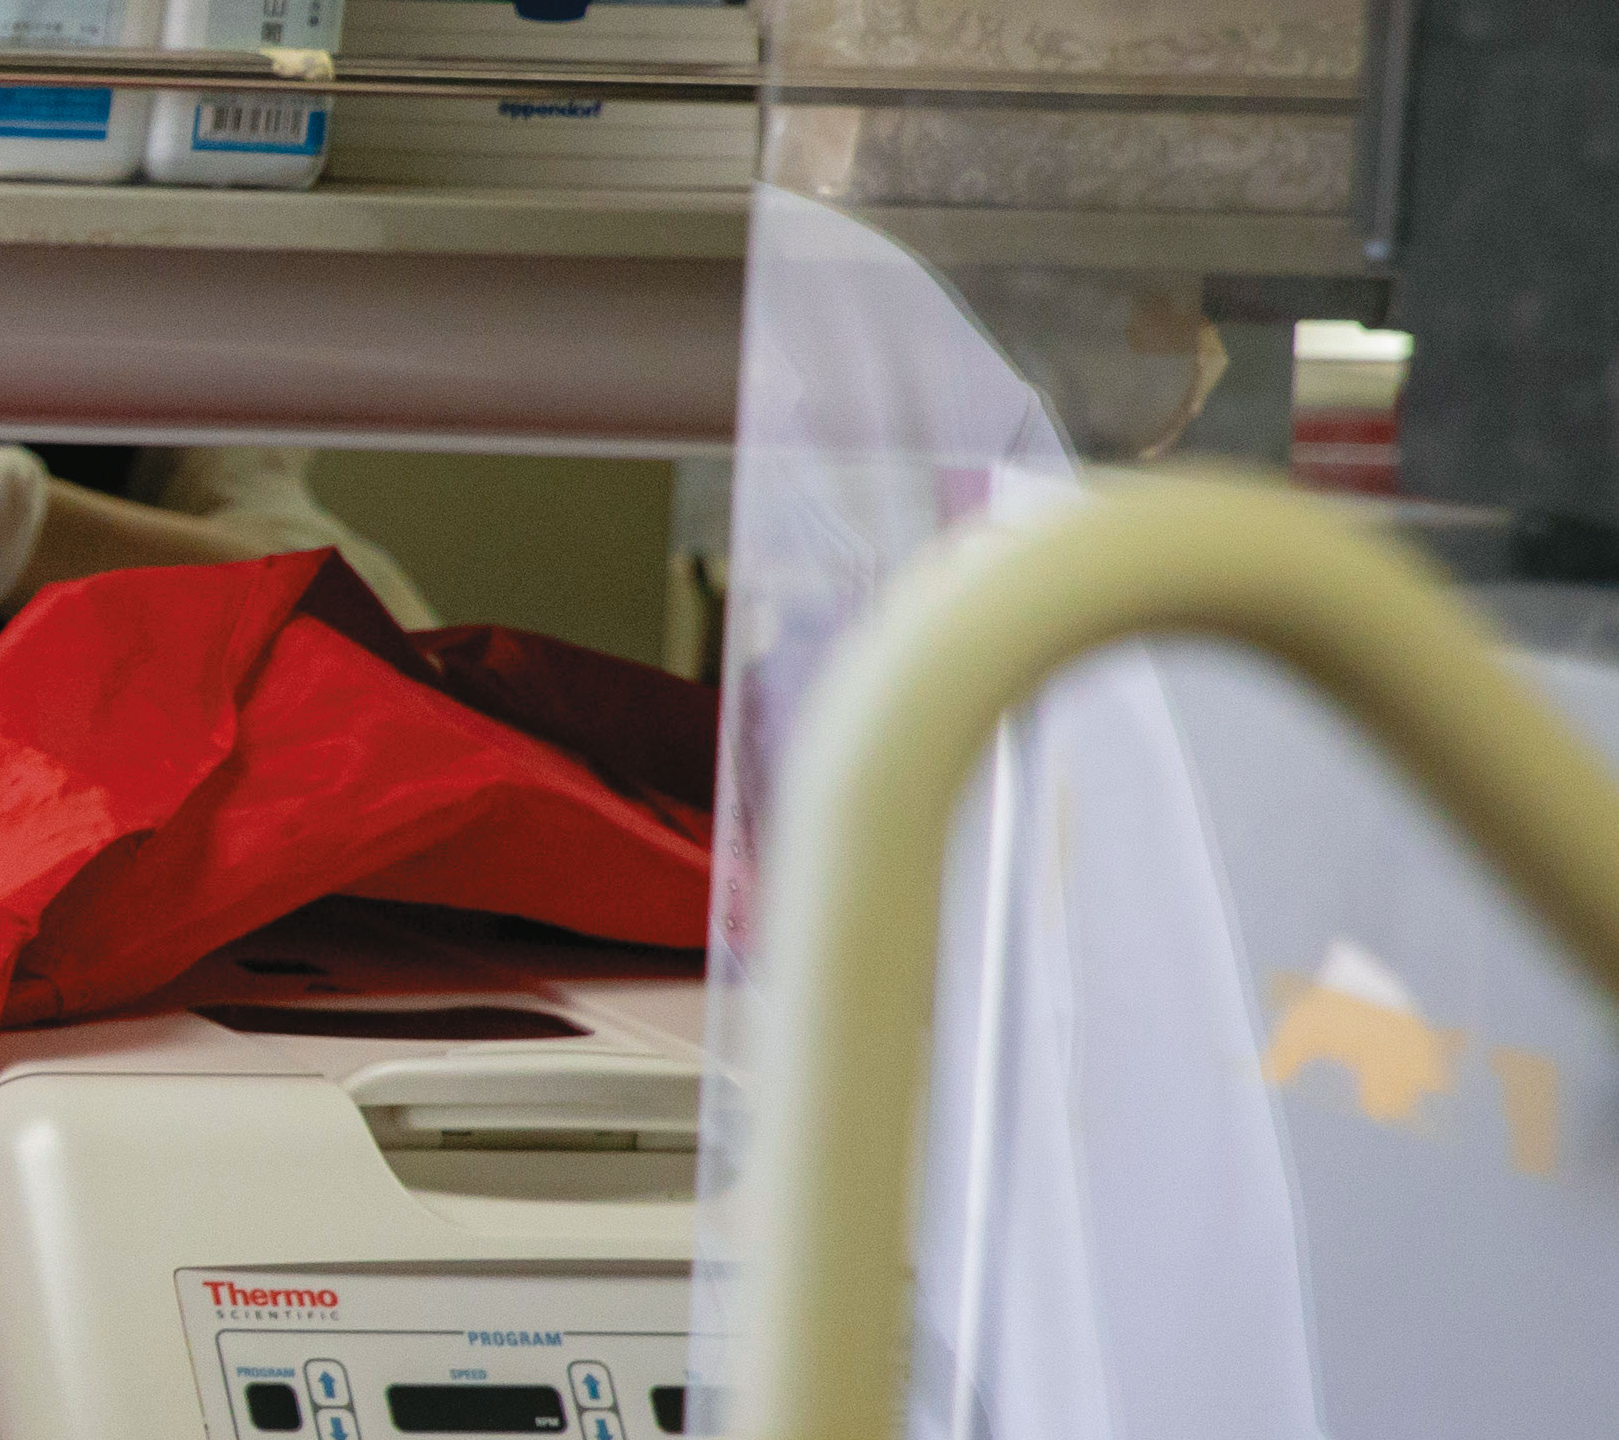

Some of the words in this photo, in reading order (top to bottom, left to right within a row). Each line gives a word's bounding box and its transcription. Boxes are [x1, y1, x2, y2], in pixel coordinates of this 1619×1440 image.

[203, 1281, 339, 1309] Thermo
[216, 1309, 340, 1322] SCIENTIFIC
[466, 1330, 564, 1347] PROGRAM
[236, 1366, 296, 1379] PROGRAM
[449, 1368, 488, 1381] SPEED
